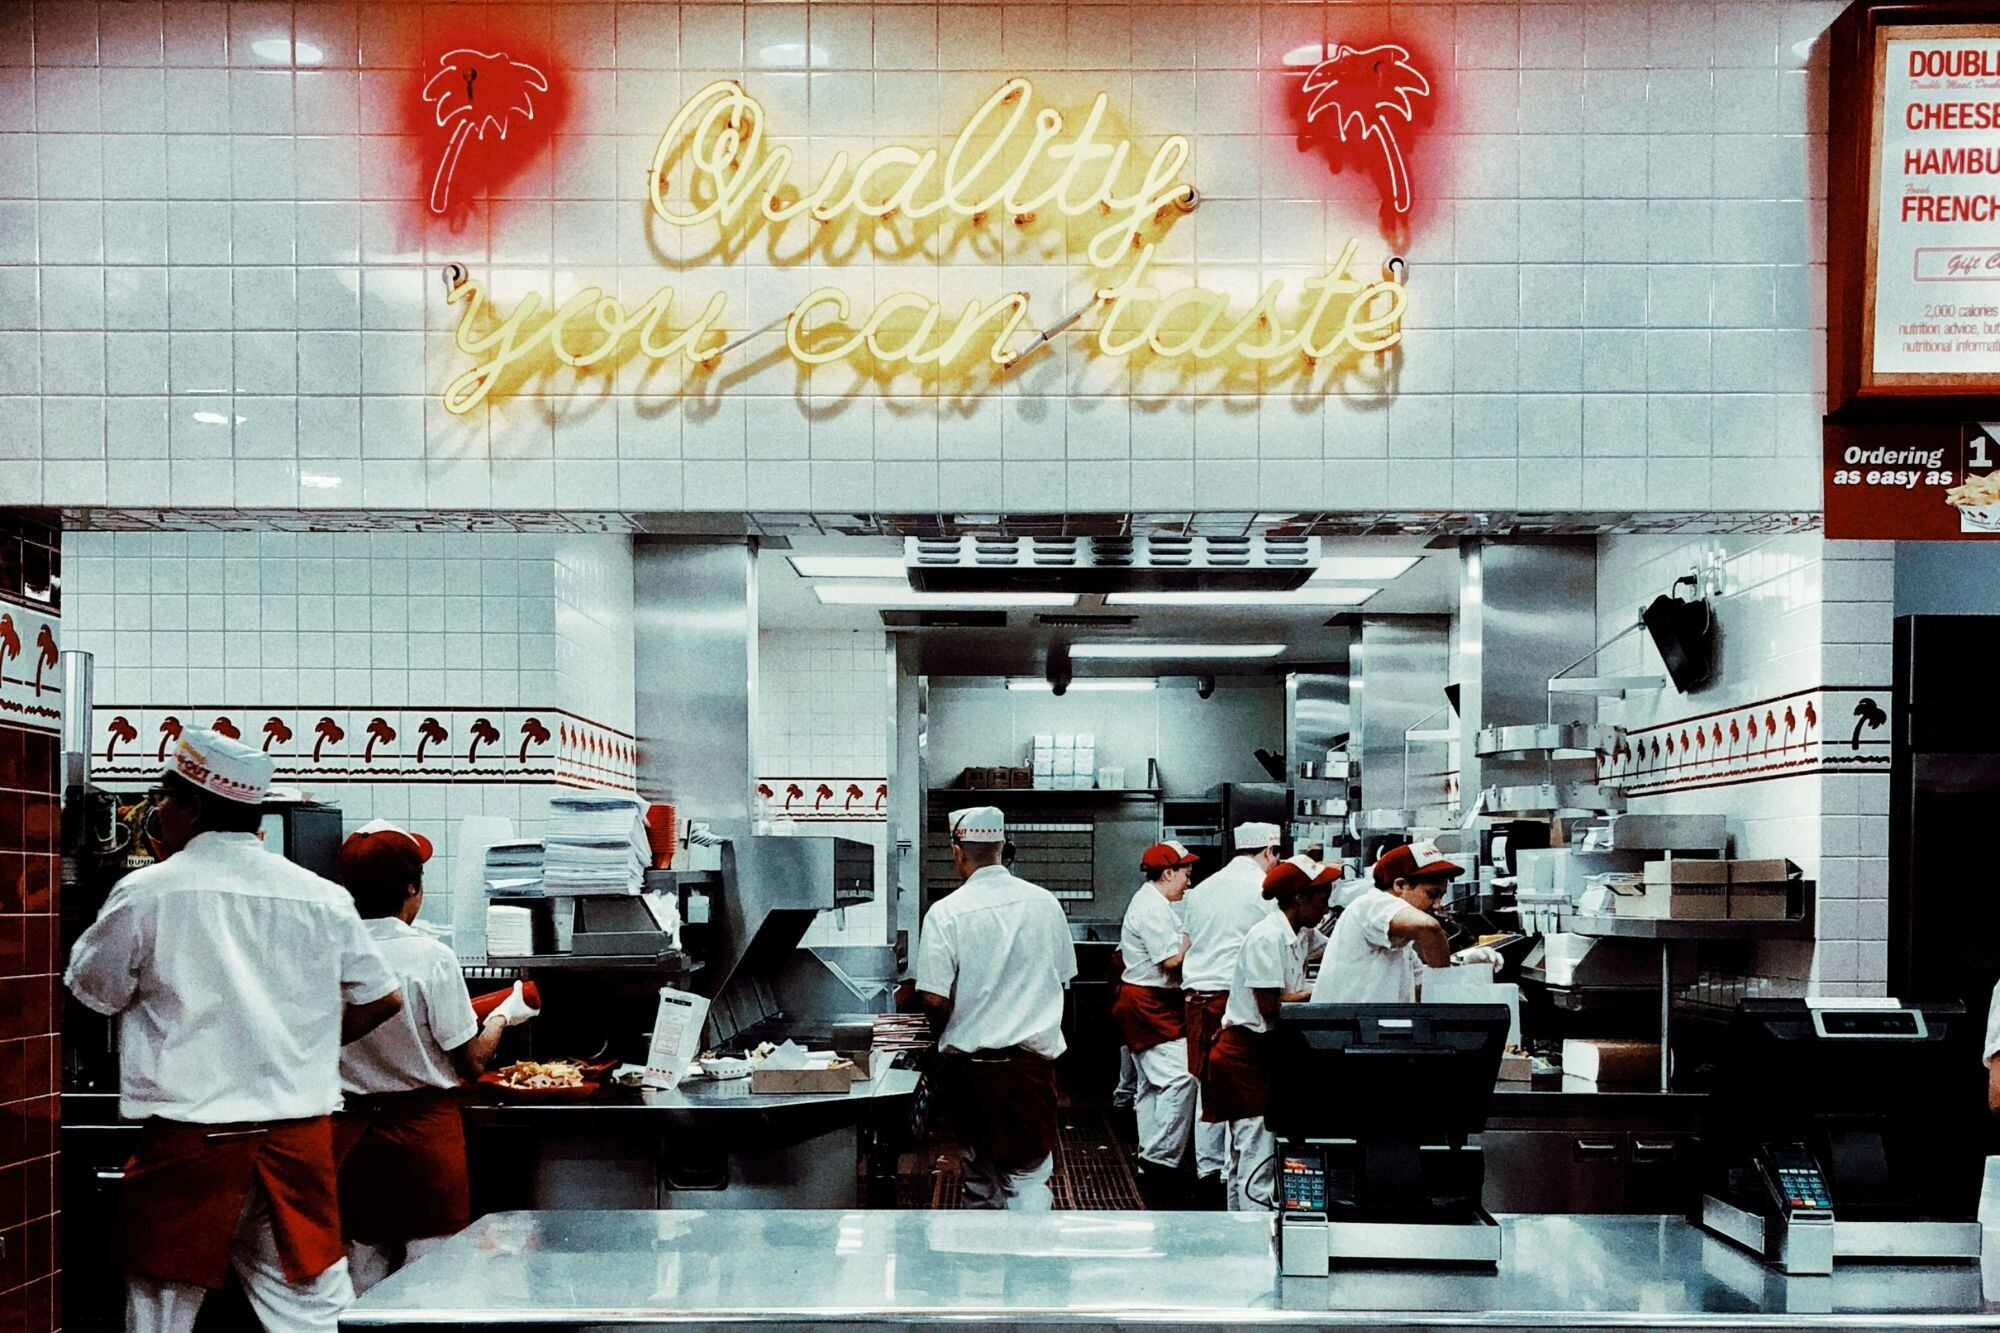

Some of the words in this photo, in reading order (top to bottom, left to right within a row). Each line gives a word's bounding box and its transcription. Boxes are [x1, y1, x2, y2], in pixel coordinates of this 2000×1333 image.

[1909, 50, 2000, 78] DOUBL
[1904, 147, 2000, 175] HAMBU
[650, 77, 1191, 268] Quality
[1947, 254, 1981, 275] Gift
[1924, 304, 1956, 319] 2,000
[1959, 304, 1998, 317] calories
[444, 279, 727, 415] you
[786, 286, 1028, 367] can
[1096, 238, 1407, 358] taste
[1899, 322, 1941, 335] nutrition
[1902, 340, 1952, 352] nutritional
[1844, 446, 1944, 468] Ordering
[1968, 436, 1993, 467] 1
[1833, 470, 1861, 484] as
[1866, 470, 1921, 489] easy
[1925, 470, 1953, 484] as
